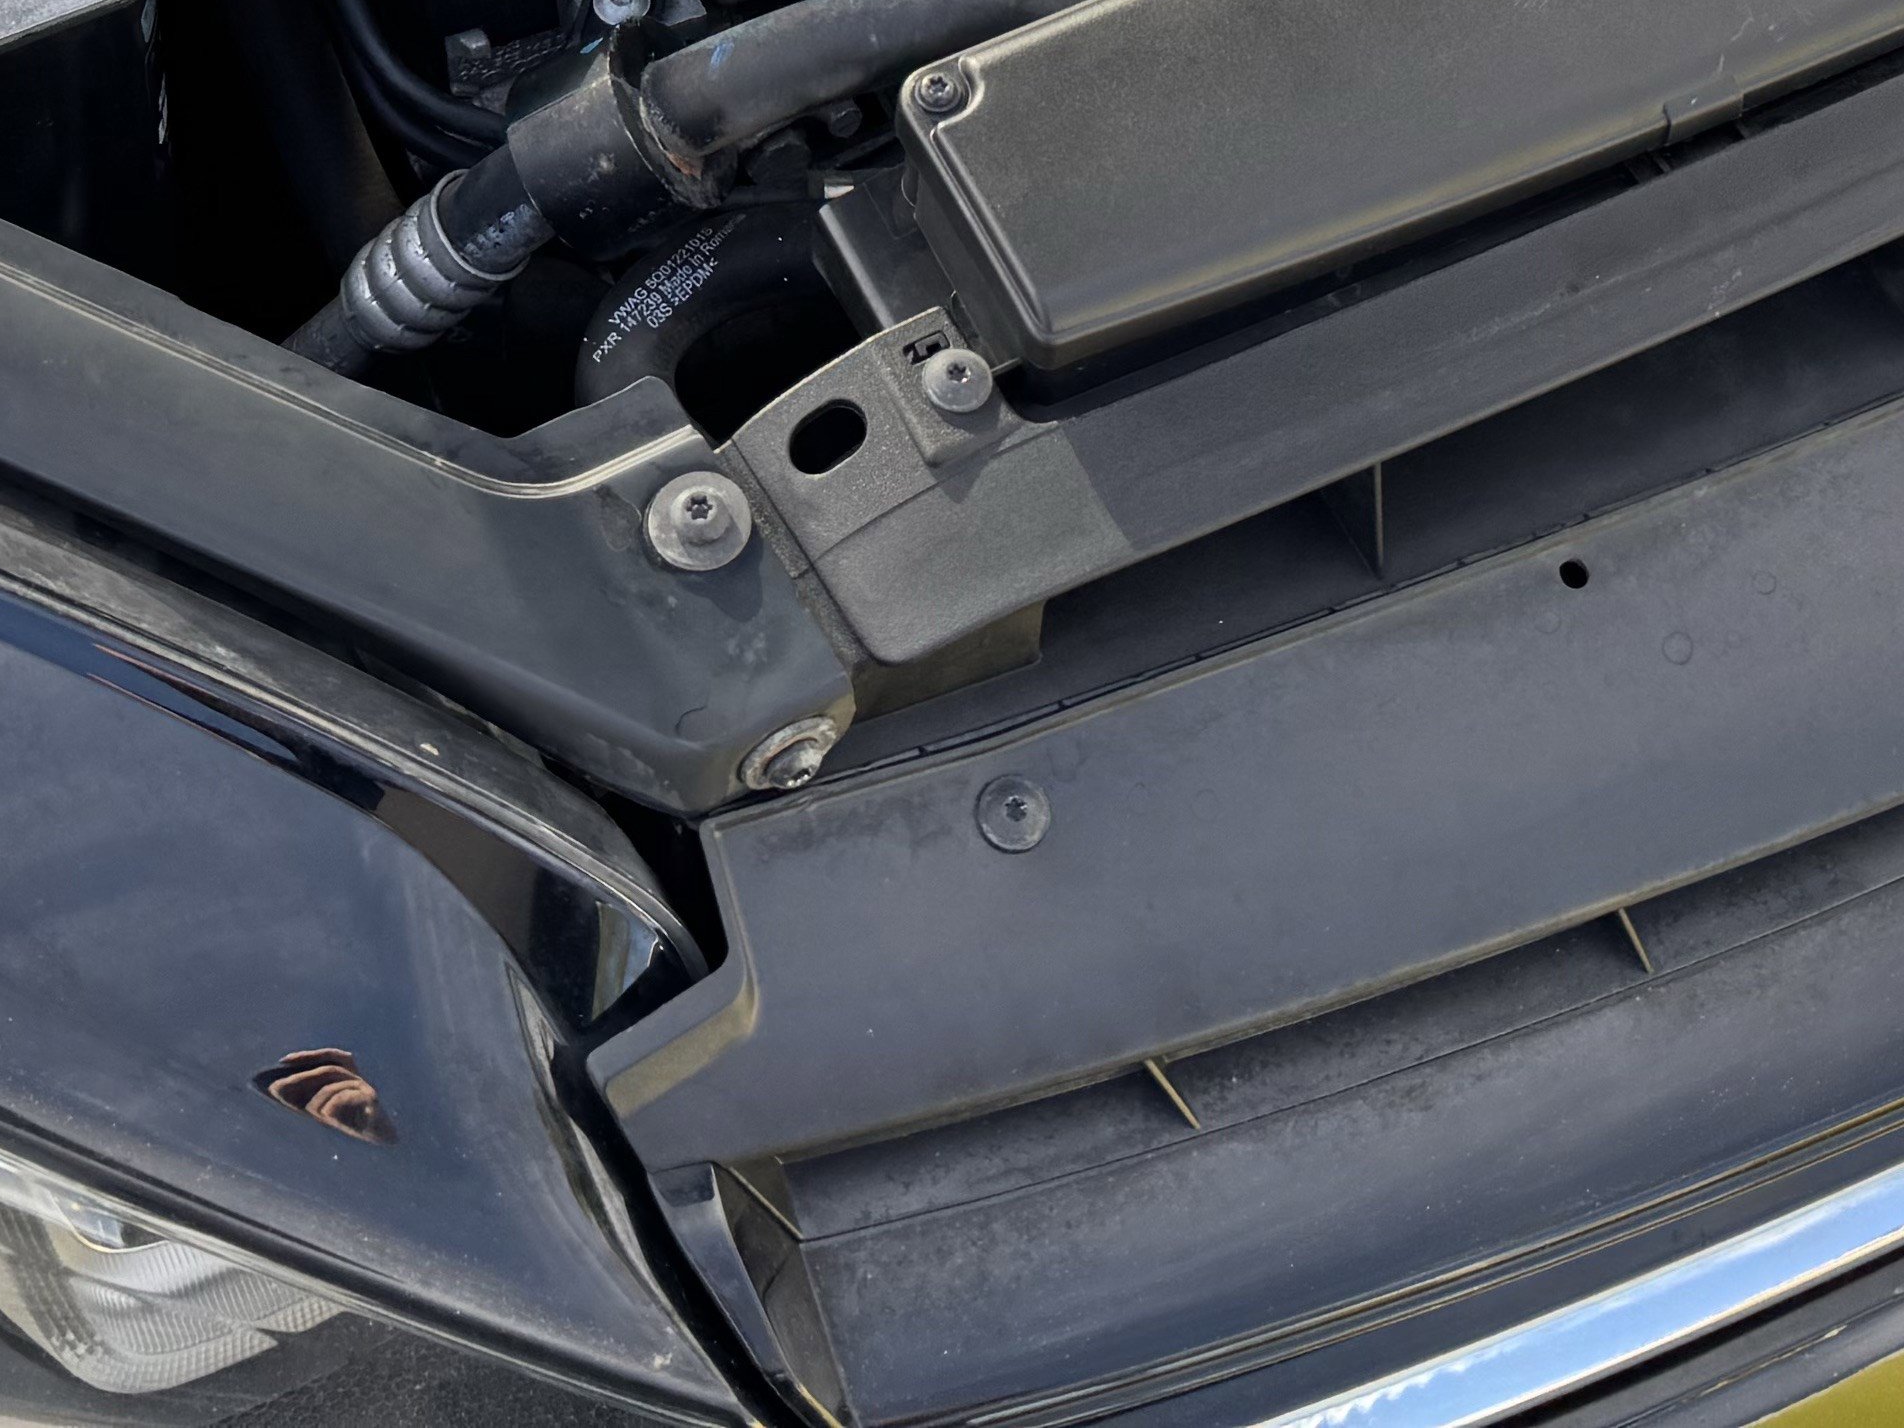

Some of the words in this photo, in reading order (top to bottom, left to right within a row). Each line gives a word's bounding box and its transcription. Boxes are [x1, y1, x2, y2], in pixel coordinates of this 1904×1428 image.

[592, 331, 623, 363] PXR
[619, 291, 662, 333] 147239
[658, 264, 694, 299] Made
[608, 286, 648, 327] VWAG
[645, 301, 674, 330] 03S
